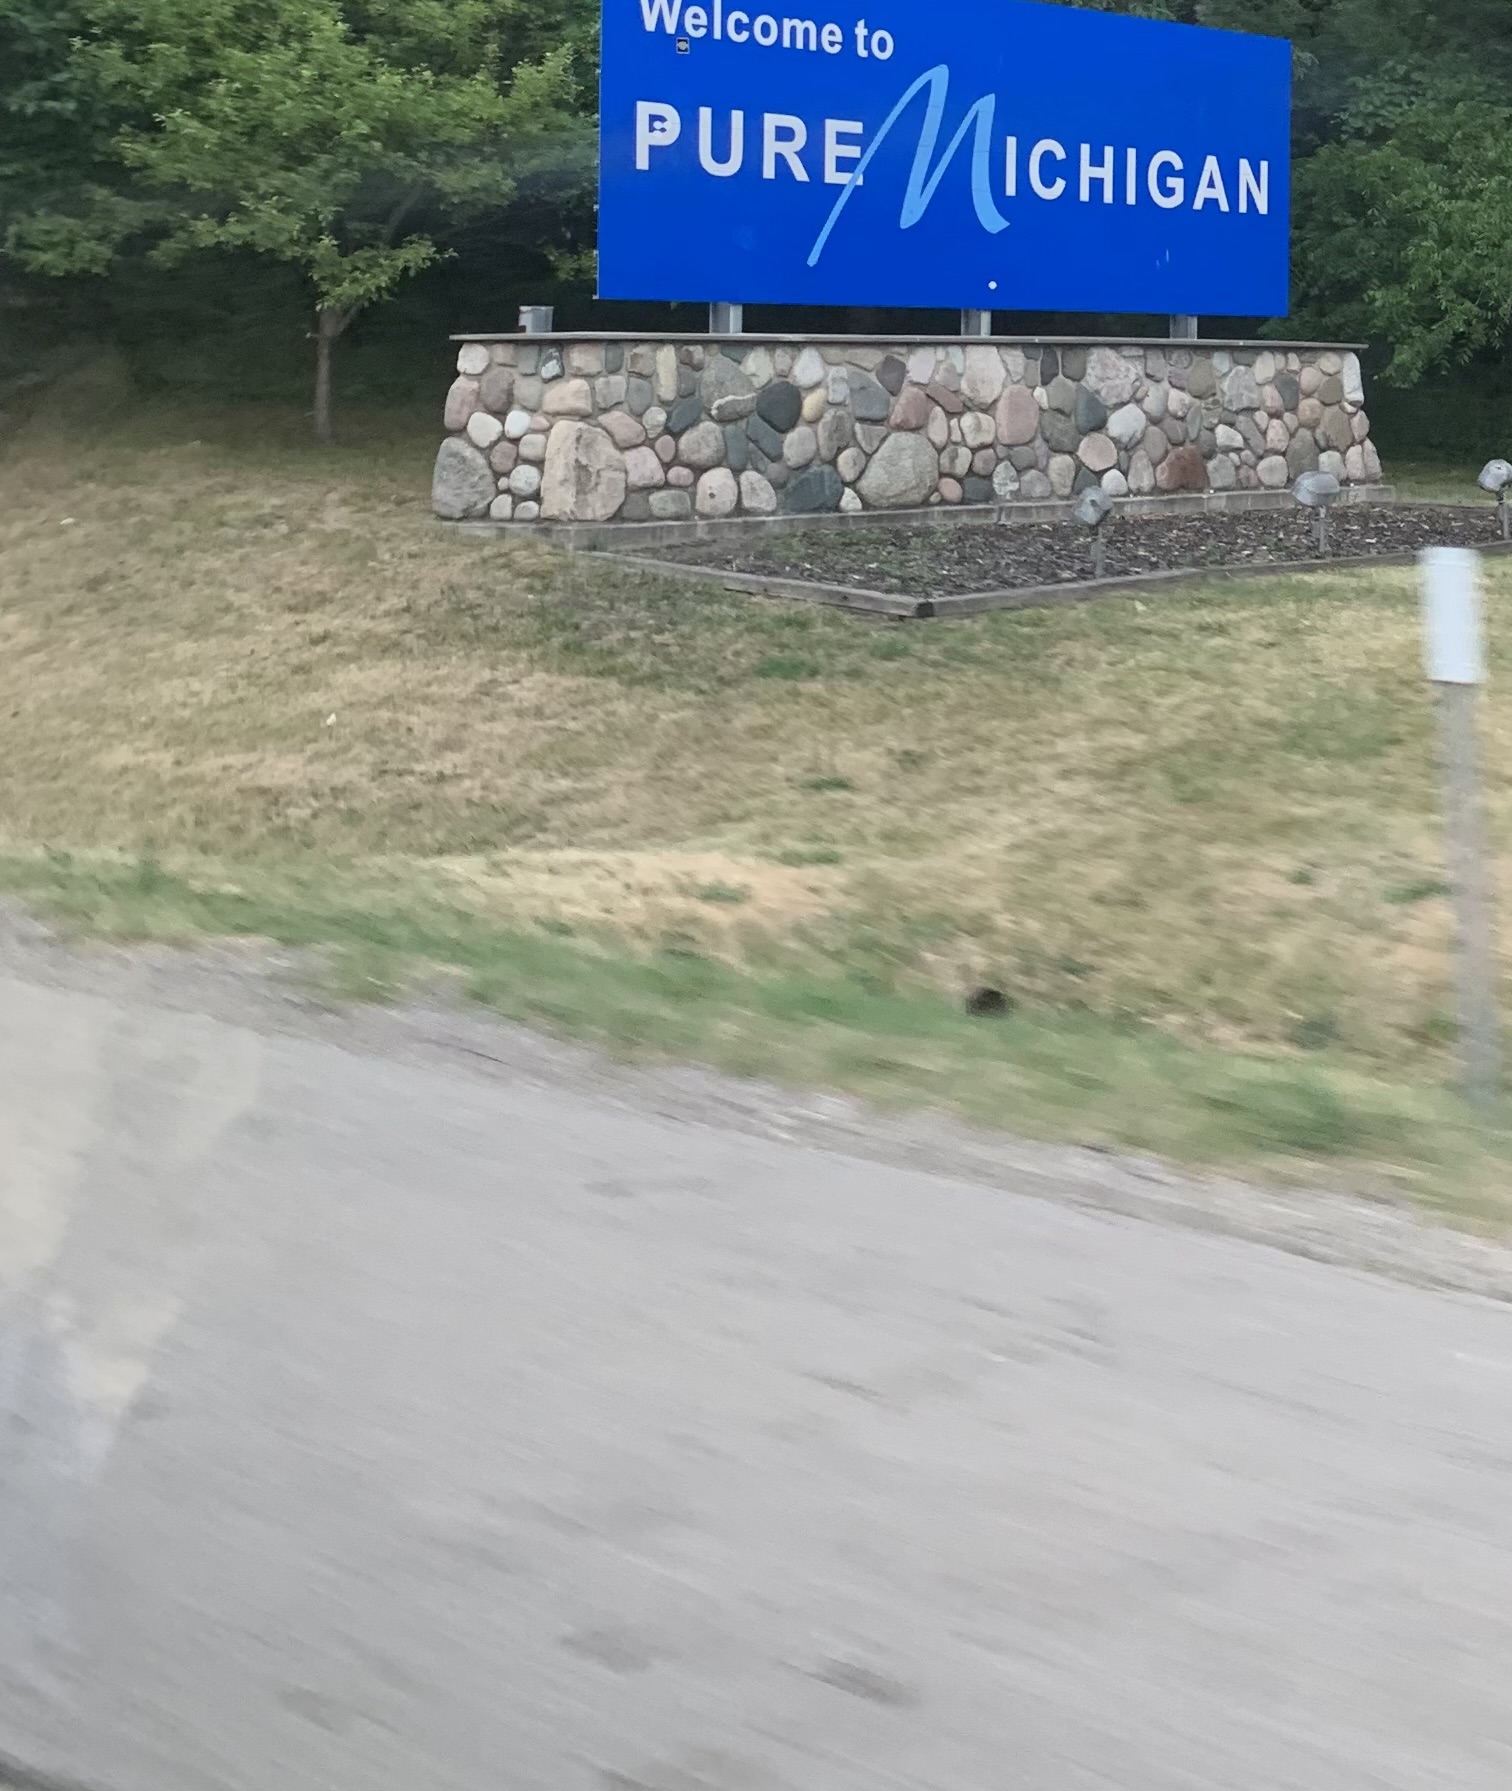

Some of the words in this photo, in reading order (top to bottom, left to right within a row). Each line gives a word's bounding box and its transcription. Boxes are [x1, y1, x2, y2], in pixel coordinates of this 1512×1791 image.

[855, 19, 894, 60] to
[635, 101, 864, 186] PURE
[807, 64, 1269, 267] MICHIGAN
